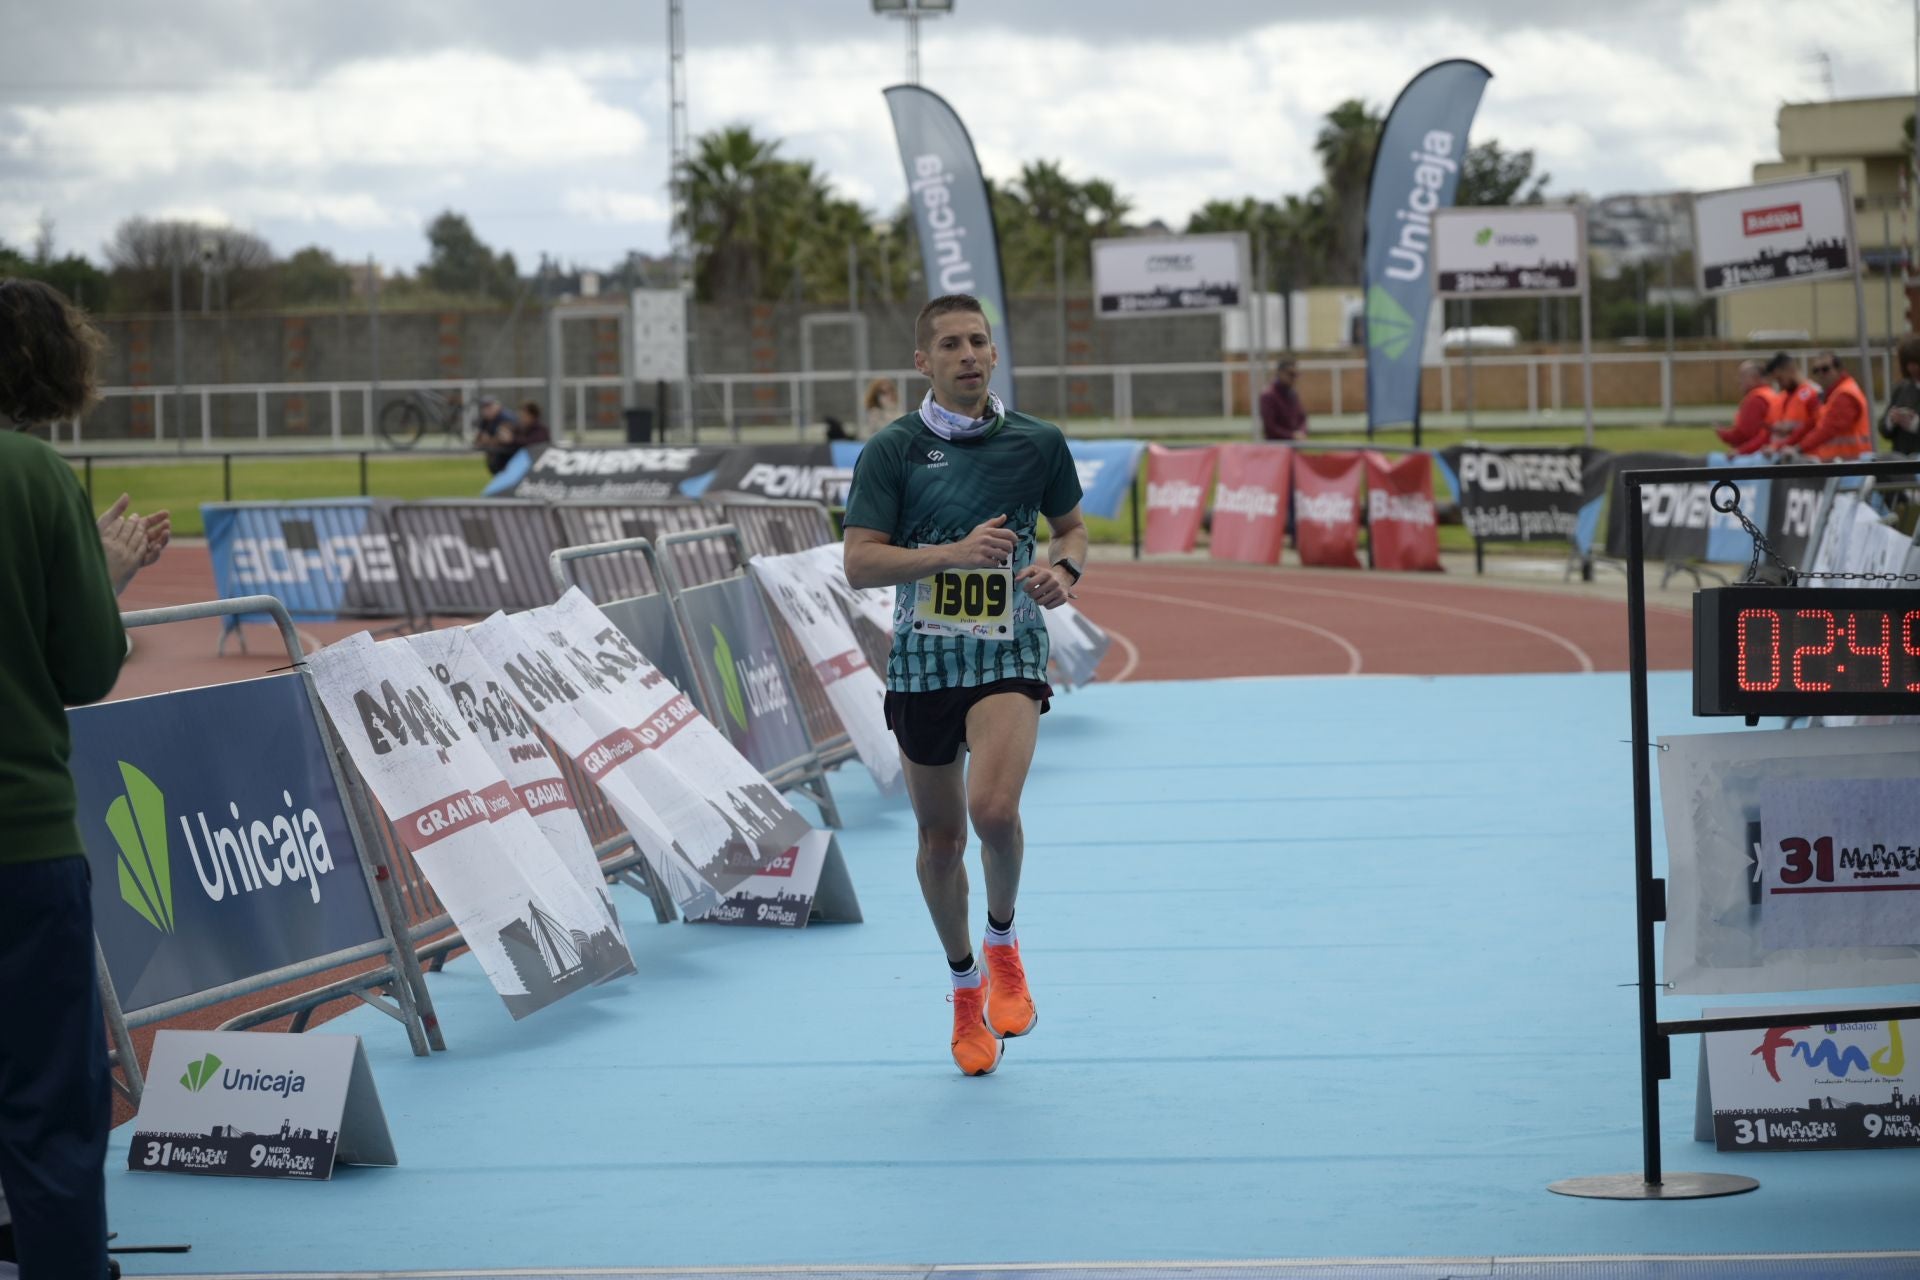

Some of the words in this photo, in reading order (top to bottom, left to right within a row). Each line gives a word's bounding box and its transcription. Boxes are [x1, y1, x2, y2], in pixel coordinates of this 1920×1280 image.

[1385, 129, 1458, 282] Unicaja
[934, 572, 1007, 617] 1309
[416, 796, 473, 836] GRAN
[180, 789, 335, 904] Unicaja
[1780, 835, 1834, 884] 31
[1853, 870, 1900, 879] POPULAR
[757, 904, 768, 921] 9
[222, 1068, 306, 1098] Unicaja
[1757, 1107, 1795, 1115] BADAJOZ
[1884, 1114, 1911, 1122] MEDIO
[1734, 1119, 1768, 1144] 31
[1863, 1113, 1883, 1138] 9
[143, 1141, 173, 1167] 31
[250, 1143, 267, 1168] 9
[269, 1146, 291, 1154] MEDIO
